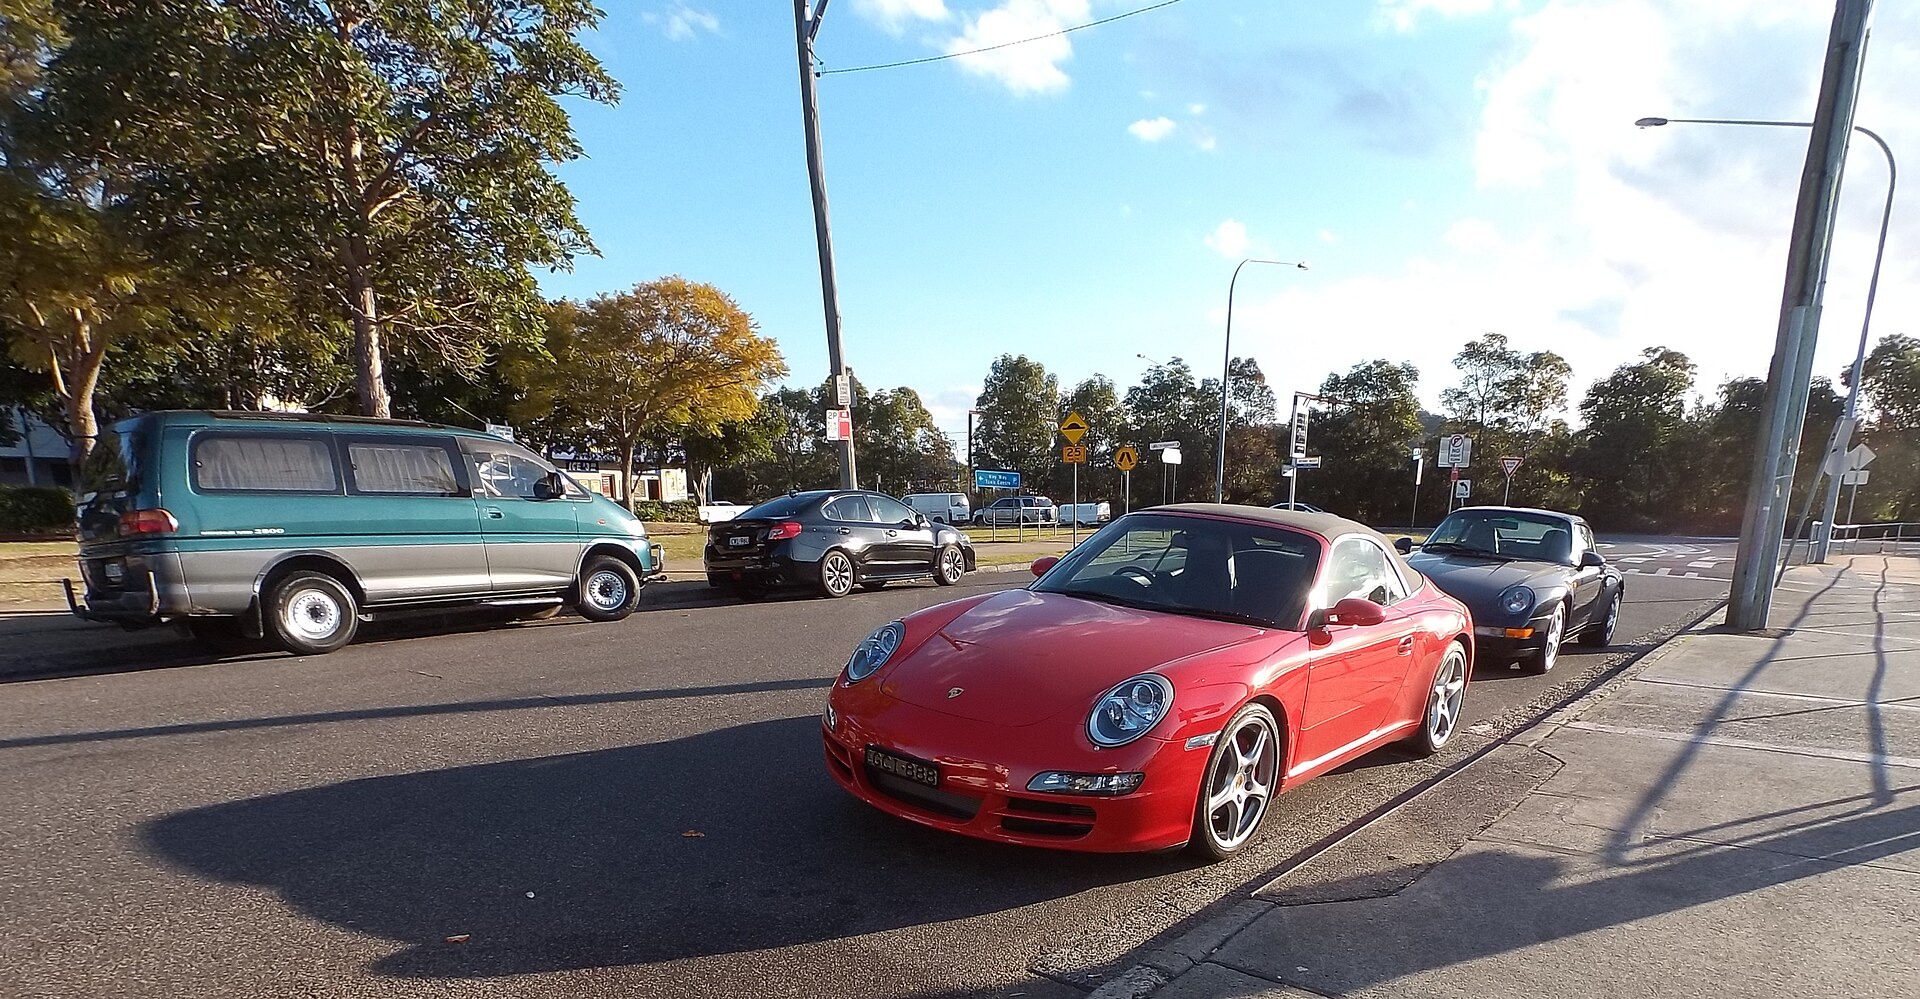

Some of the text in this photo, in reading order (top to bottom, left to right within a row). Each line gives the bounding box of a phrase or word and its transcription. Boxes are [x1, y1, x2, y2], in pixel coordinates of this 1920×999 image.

[828, 412, 838, 420] 2P
[1067, 448, 1081, 457] 25
[568, 461, 581, 471] ICE
